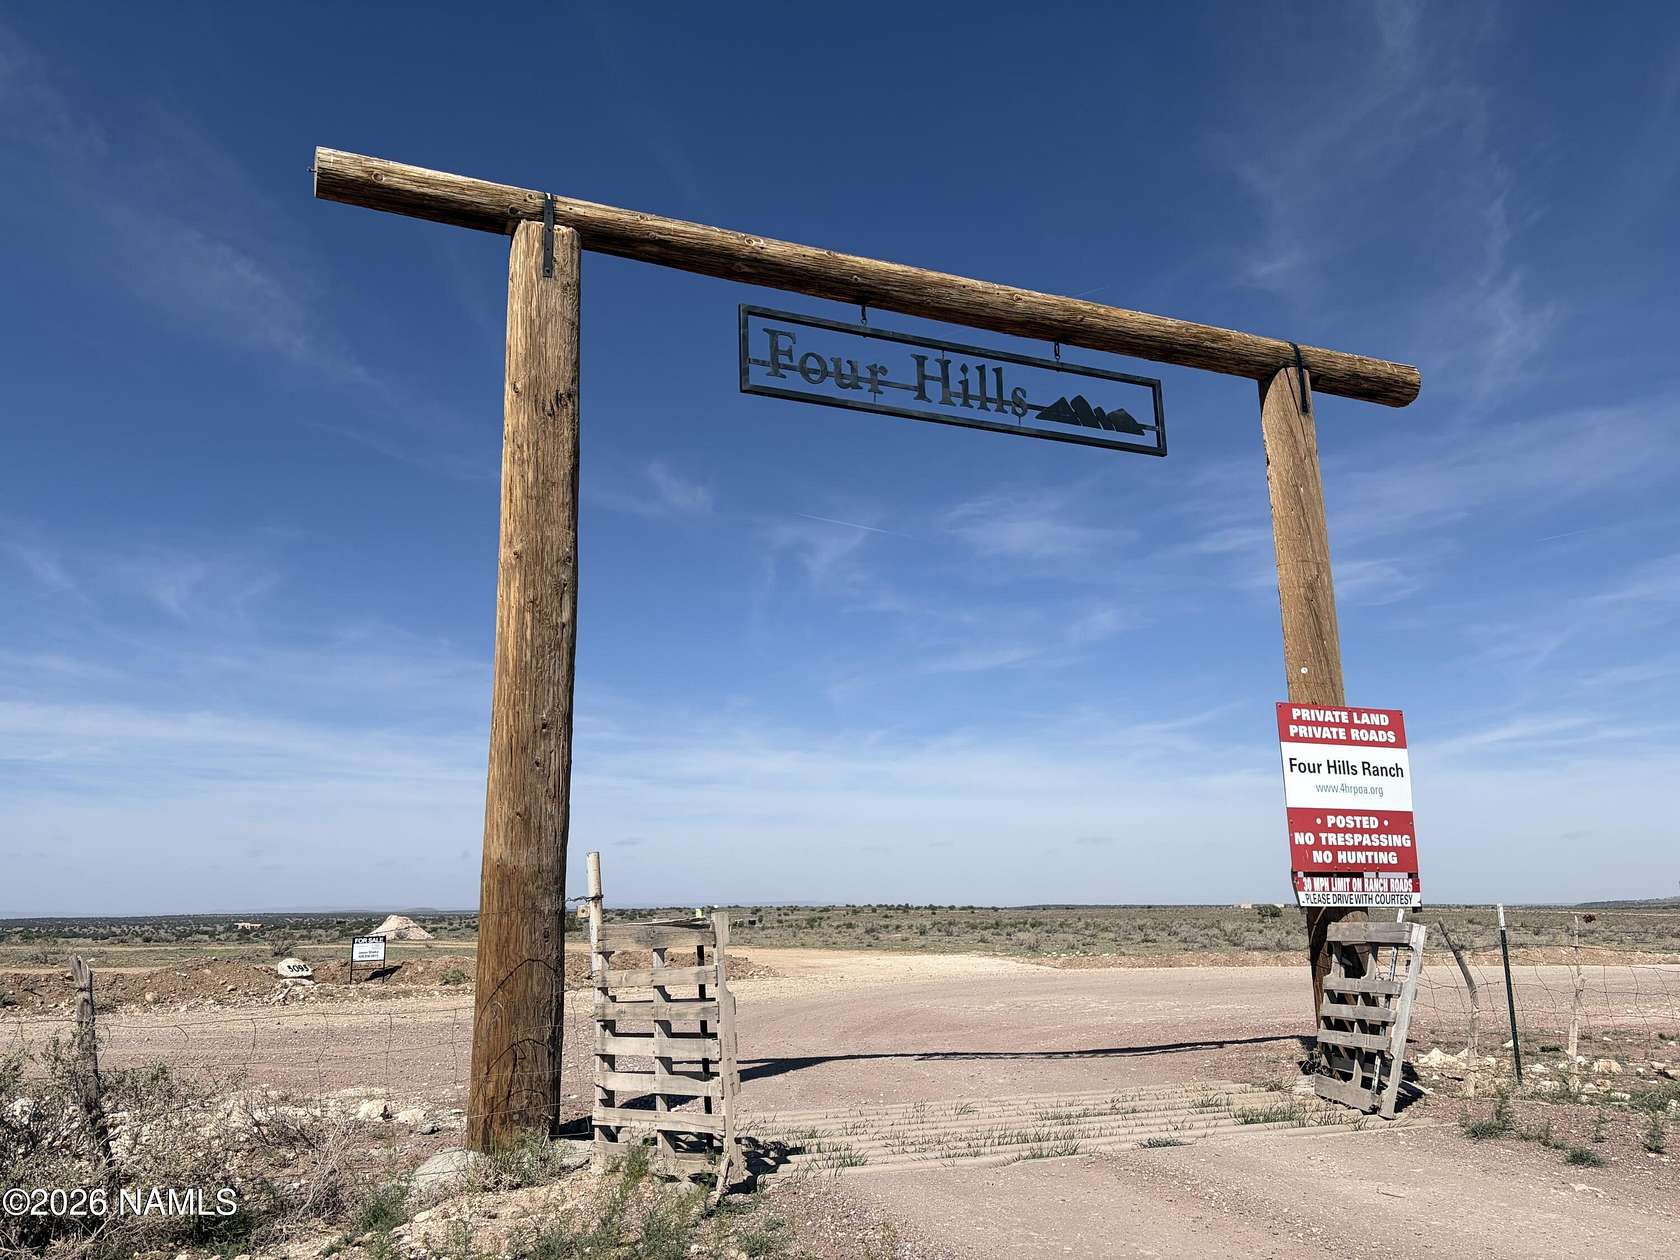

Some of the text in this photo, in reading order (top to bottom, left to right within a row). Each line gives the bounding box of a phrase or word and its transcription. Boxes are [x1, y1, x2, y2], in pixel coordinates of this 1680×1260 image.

[762, 328, 1029, 417] Four Hills
[1292, 708, 1389, 726] PRIVATE LAND
[1289, 725, 1396, 743] PRIVATE ROADS
[1289, 757, 1404, 778] Four Hills Ranch
[1315, 783, 1384, 797] www.4hrpoa.org
[1327, 815, 1379, 829] POSTED
[1294, 832, 1411, 847] NO TRESPASSING
[1312, 850, 1398, 864] NO HUNTING
[1313, 877, 1329, 892] MPH
[1331, 877, 1350, 892] LIMIT
[1352, 878, 1362, 892] ON
[1364, 878, 1388, 892] RANCH
[1390, 878, 1413, 893] ROADS
[1305, 893, 1413, 905] PLEASE DRIVE WITH COURTESY
